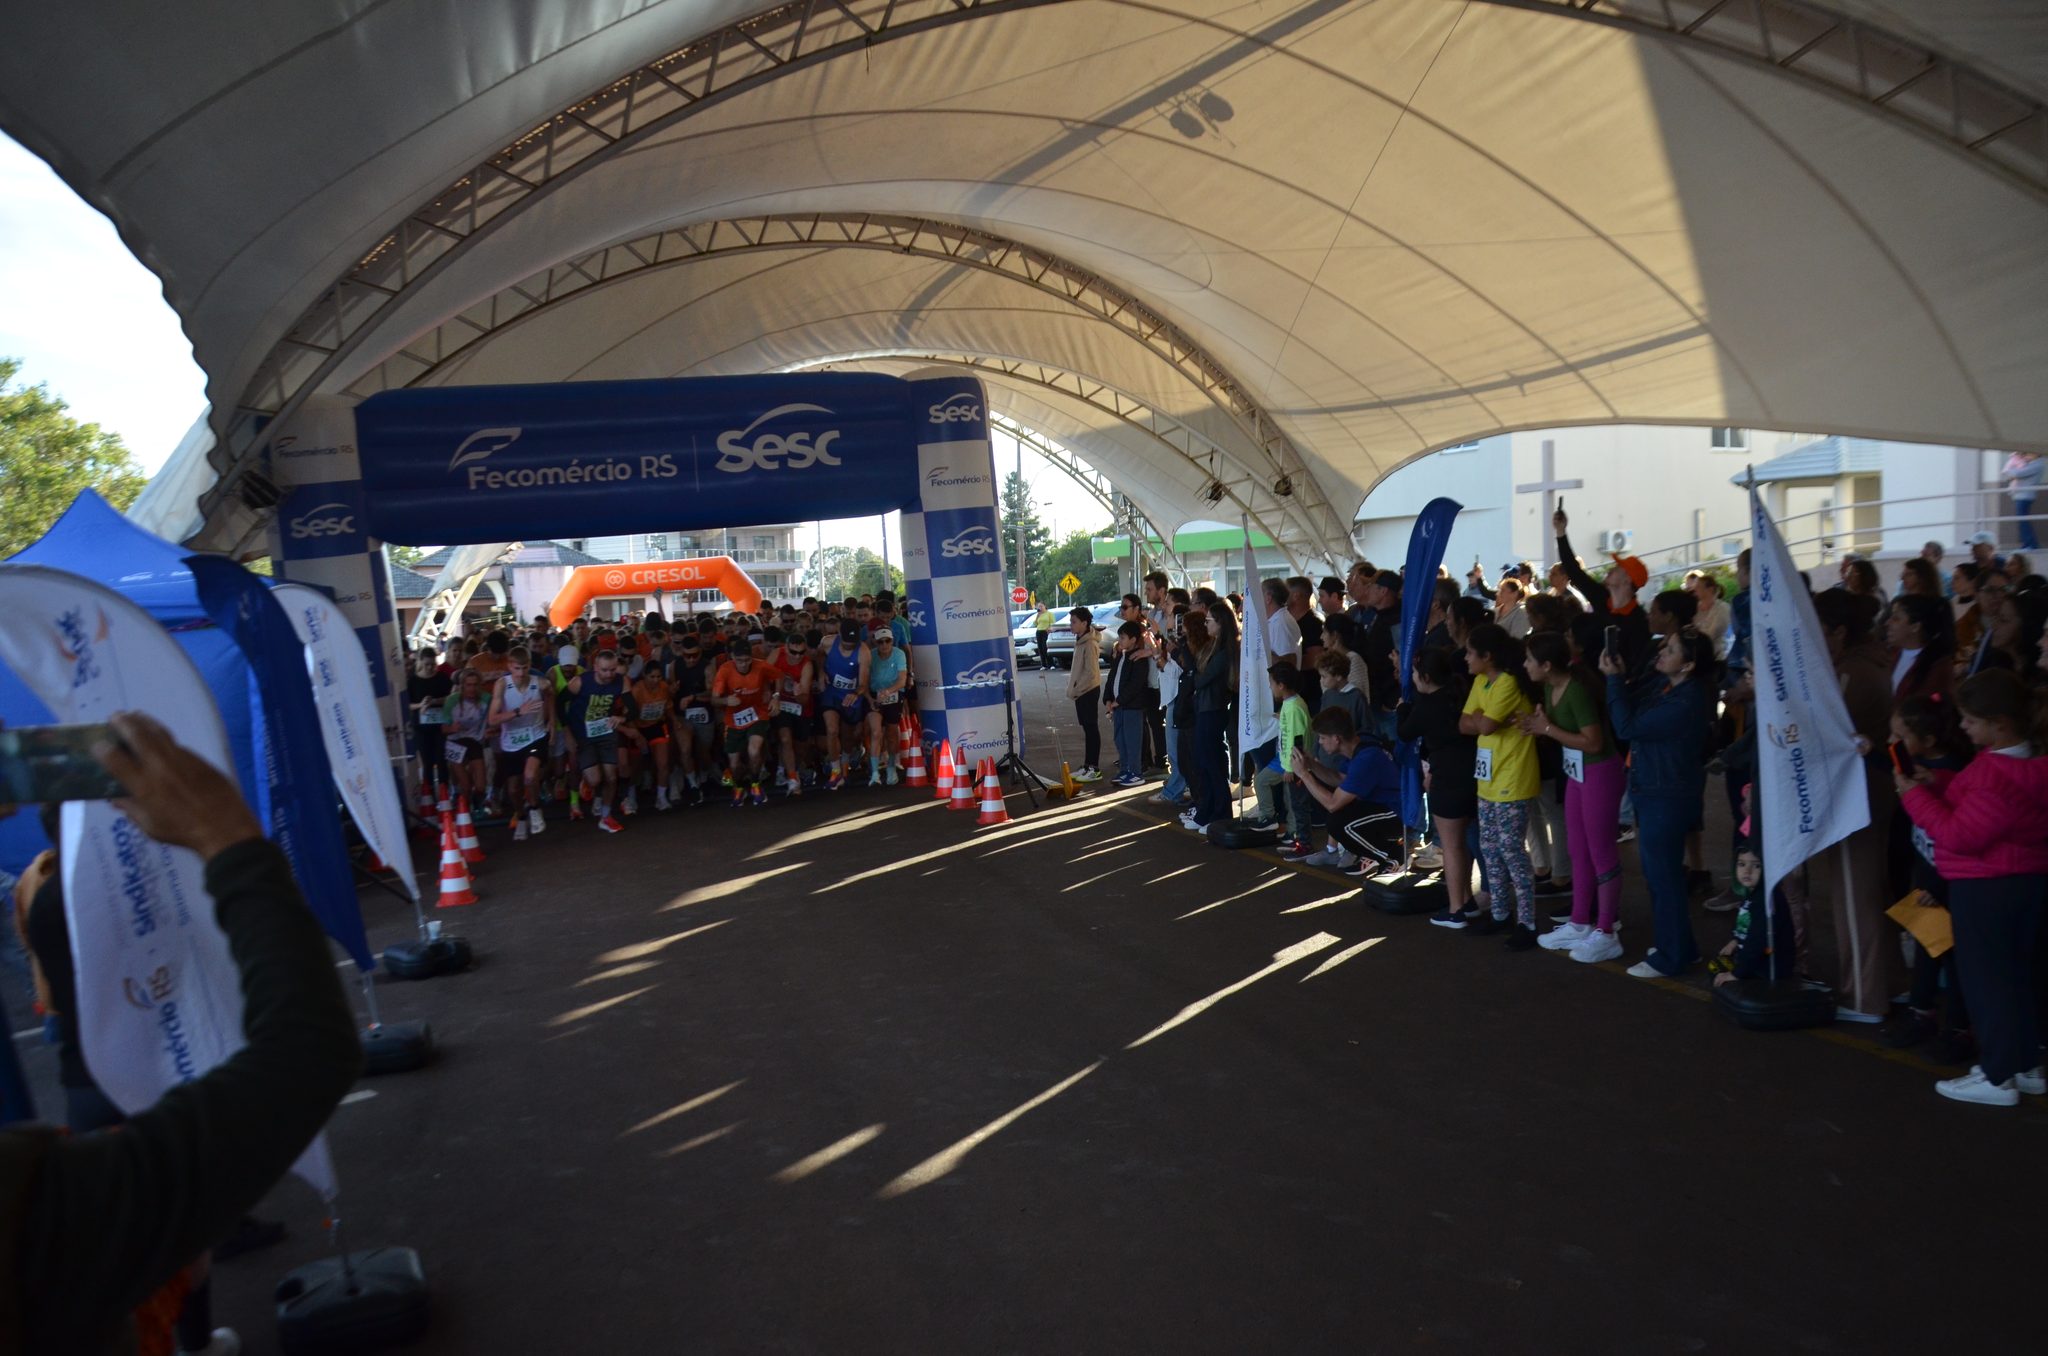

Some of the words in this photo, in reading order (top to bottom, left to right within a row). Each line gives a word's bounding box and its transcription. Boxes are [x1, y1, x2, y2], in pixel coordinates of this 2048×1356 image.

[929, 404, 981, 424] Sesc
[714, 429, 842, 473] Sesc
[467, 458, 632, 490] Fecomércio
[640, 454, 679, 479] RS
[931, 474, 981, 487] Fecomércio
[290, 515, 356, 539] Sesc
[941, 537, 994, 558] Sesc
[631, 566, 706, 586] CRESOL
[946, 607, 996, 620] Fecomércio
[956, 667, 1008, 690] Sesc
[736, 713, 754, 725] 717
[1784, 723, 1800, 744] RS
[961, 738, 1010, 751] Fecomércio
[1790, 747, 1814, 834] Fecomércio
[150, 966, 174, 1000] RS
